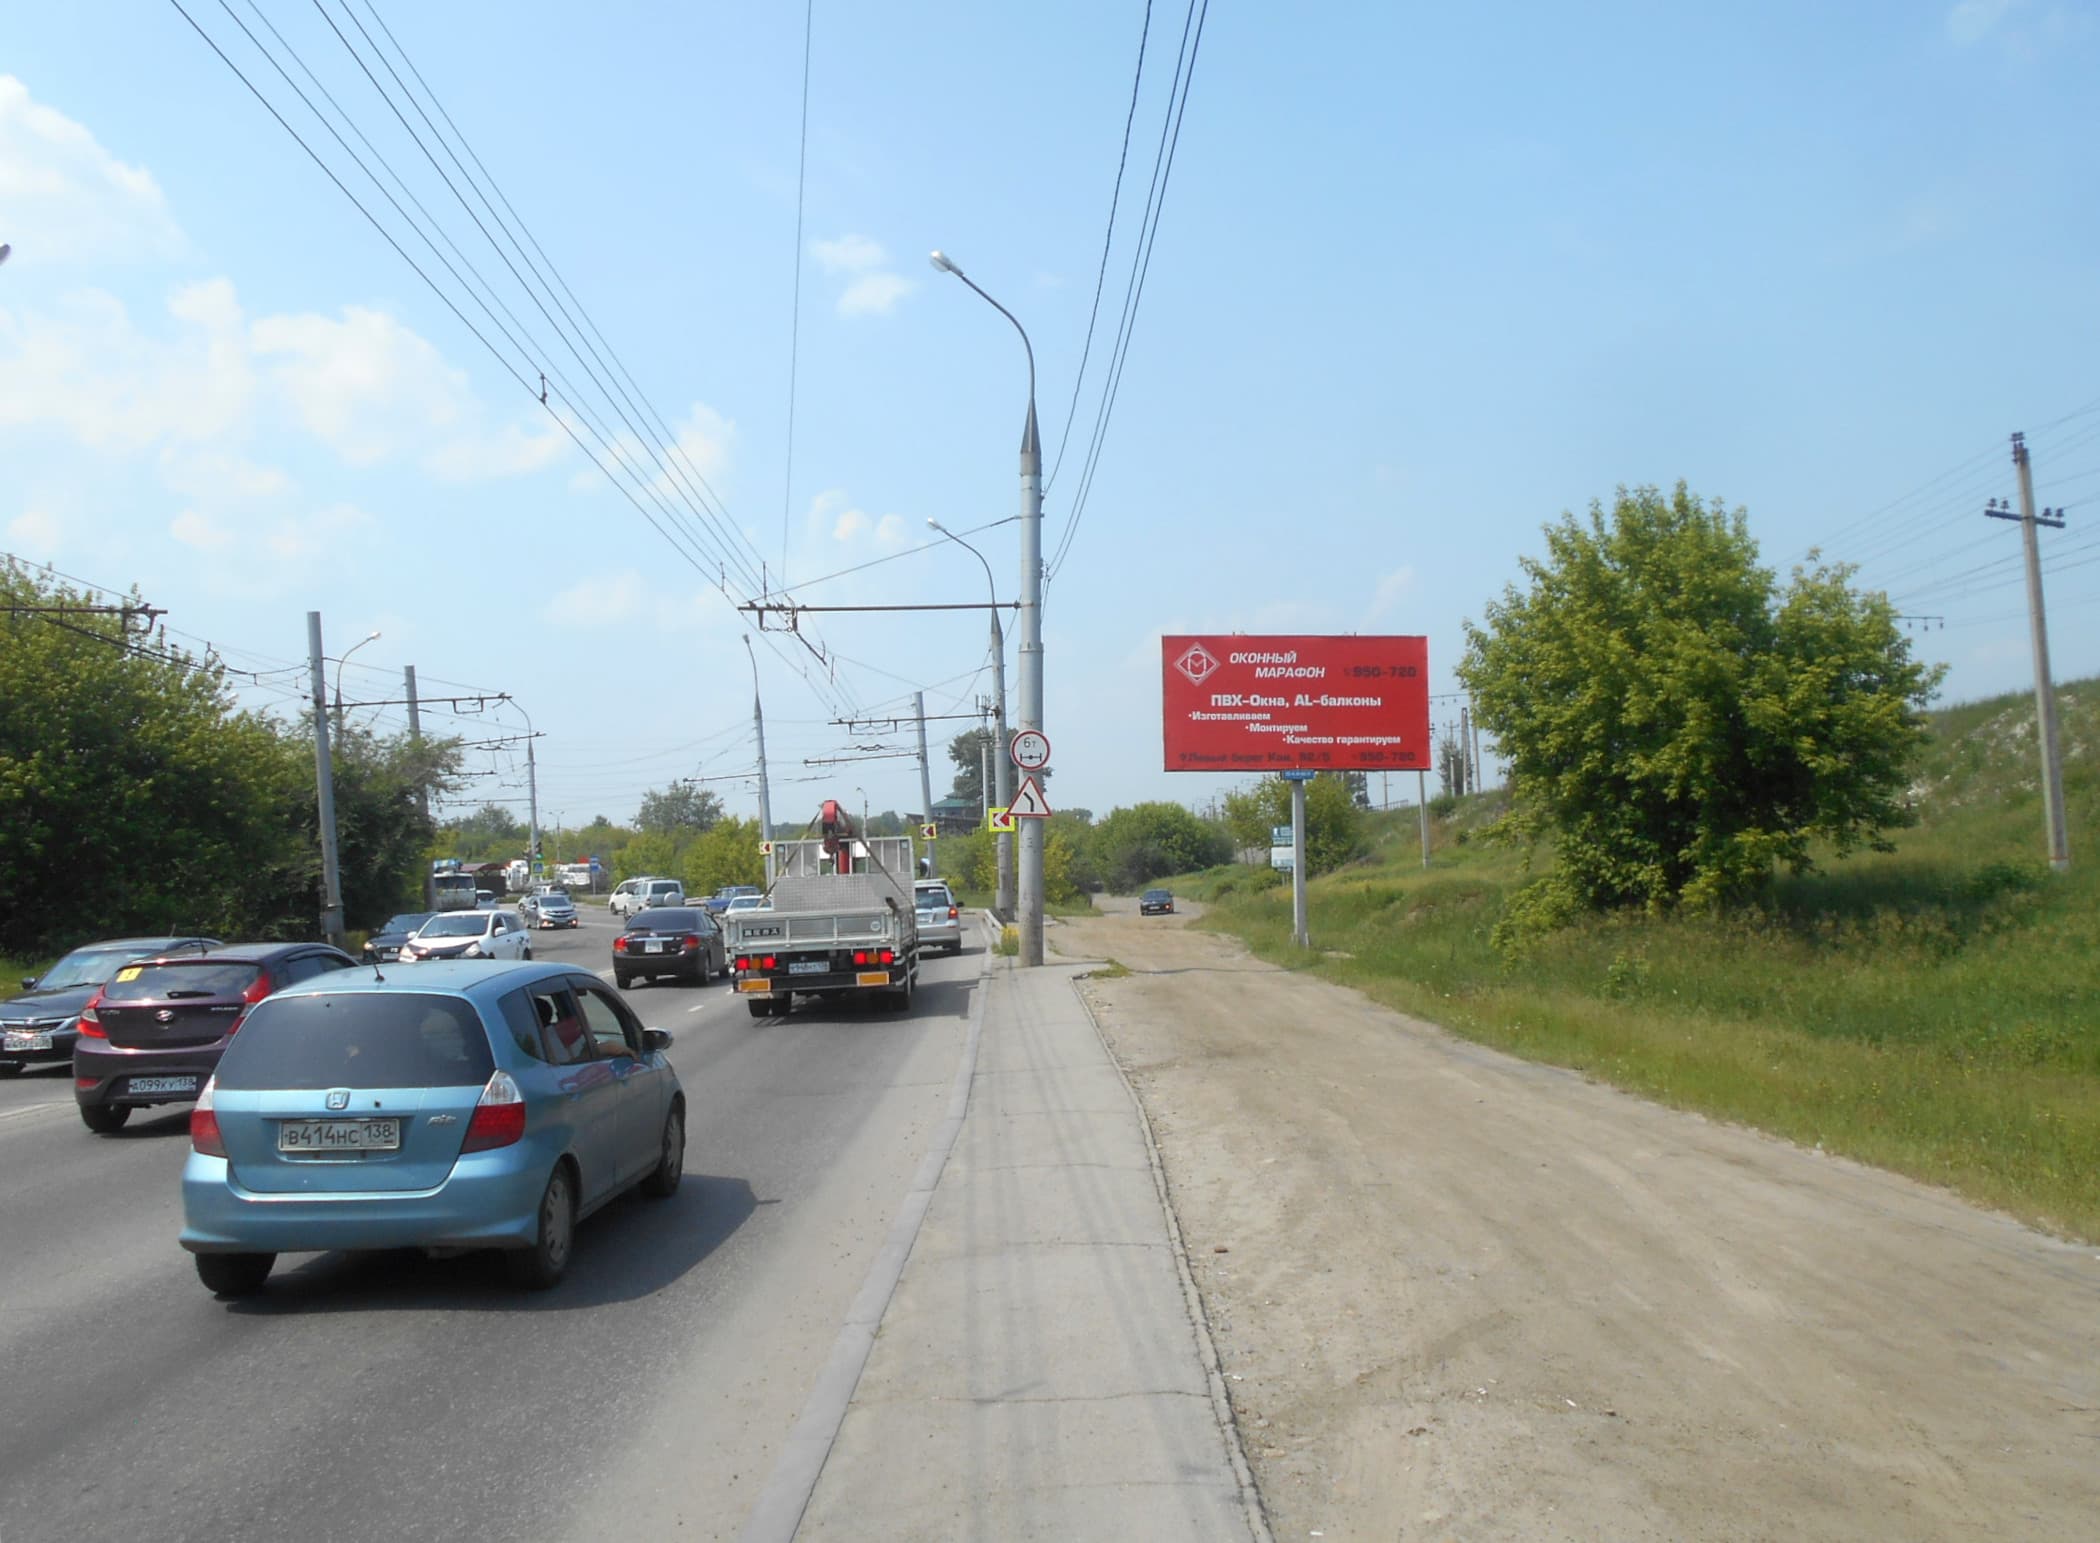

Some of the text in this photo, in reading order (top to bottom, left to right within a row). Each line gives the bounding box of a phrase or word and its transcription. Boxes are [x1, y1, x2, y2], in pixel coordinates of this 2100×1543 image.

[1229, 650, 1297, 664] ОКОННЫЙ
[1255, 667, 1326, 678] МАРАФОН
[1286, 735, 1401, 747] Качество гарантируем
